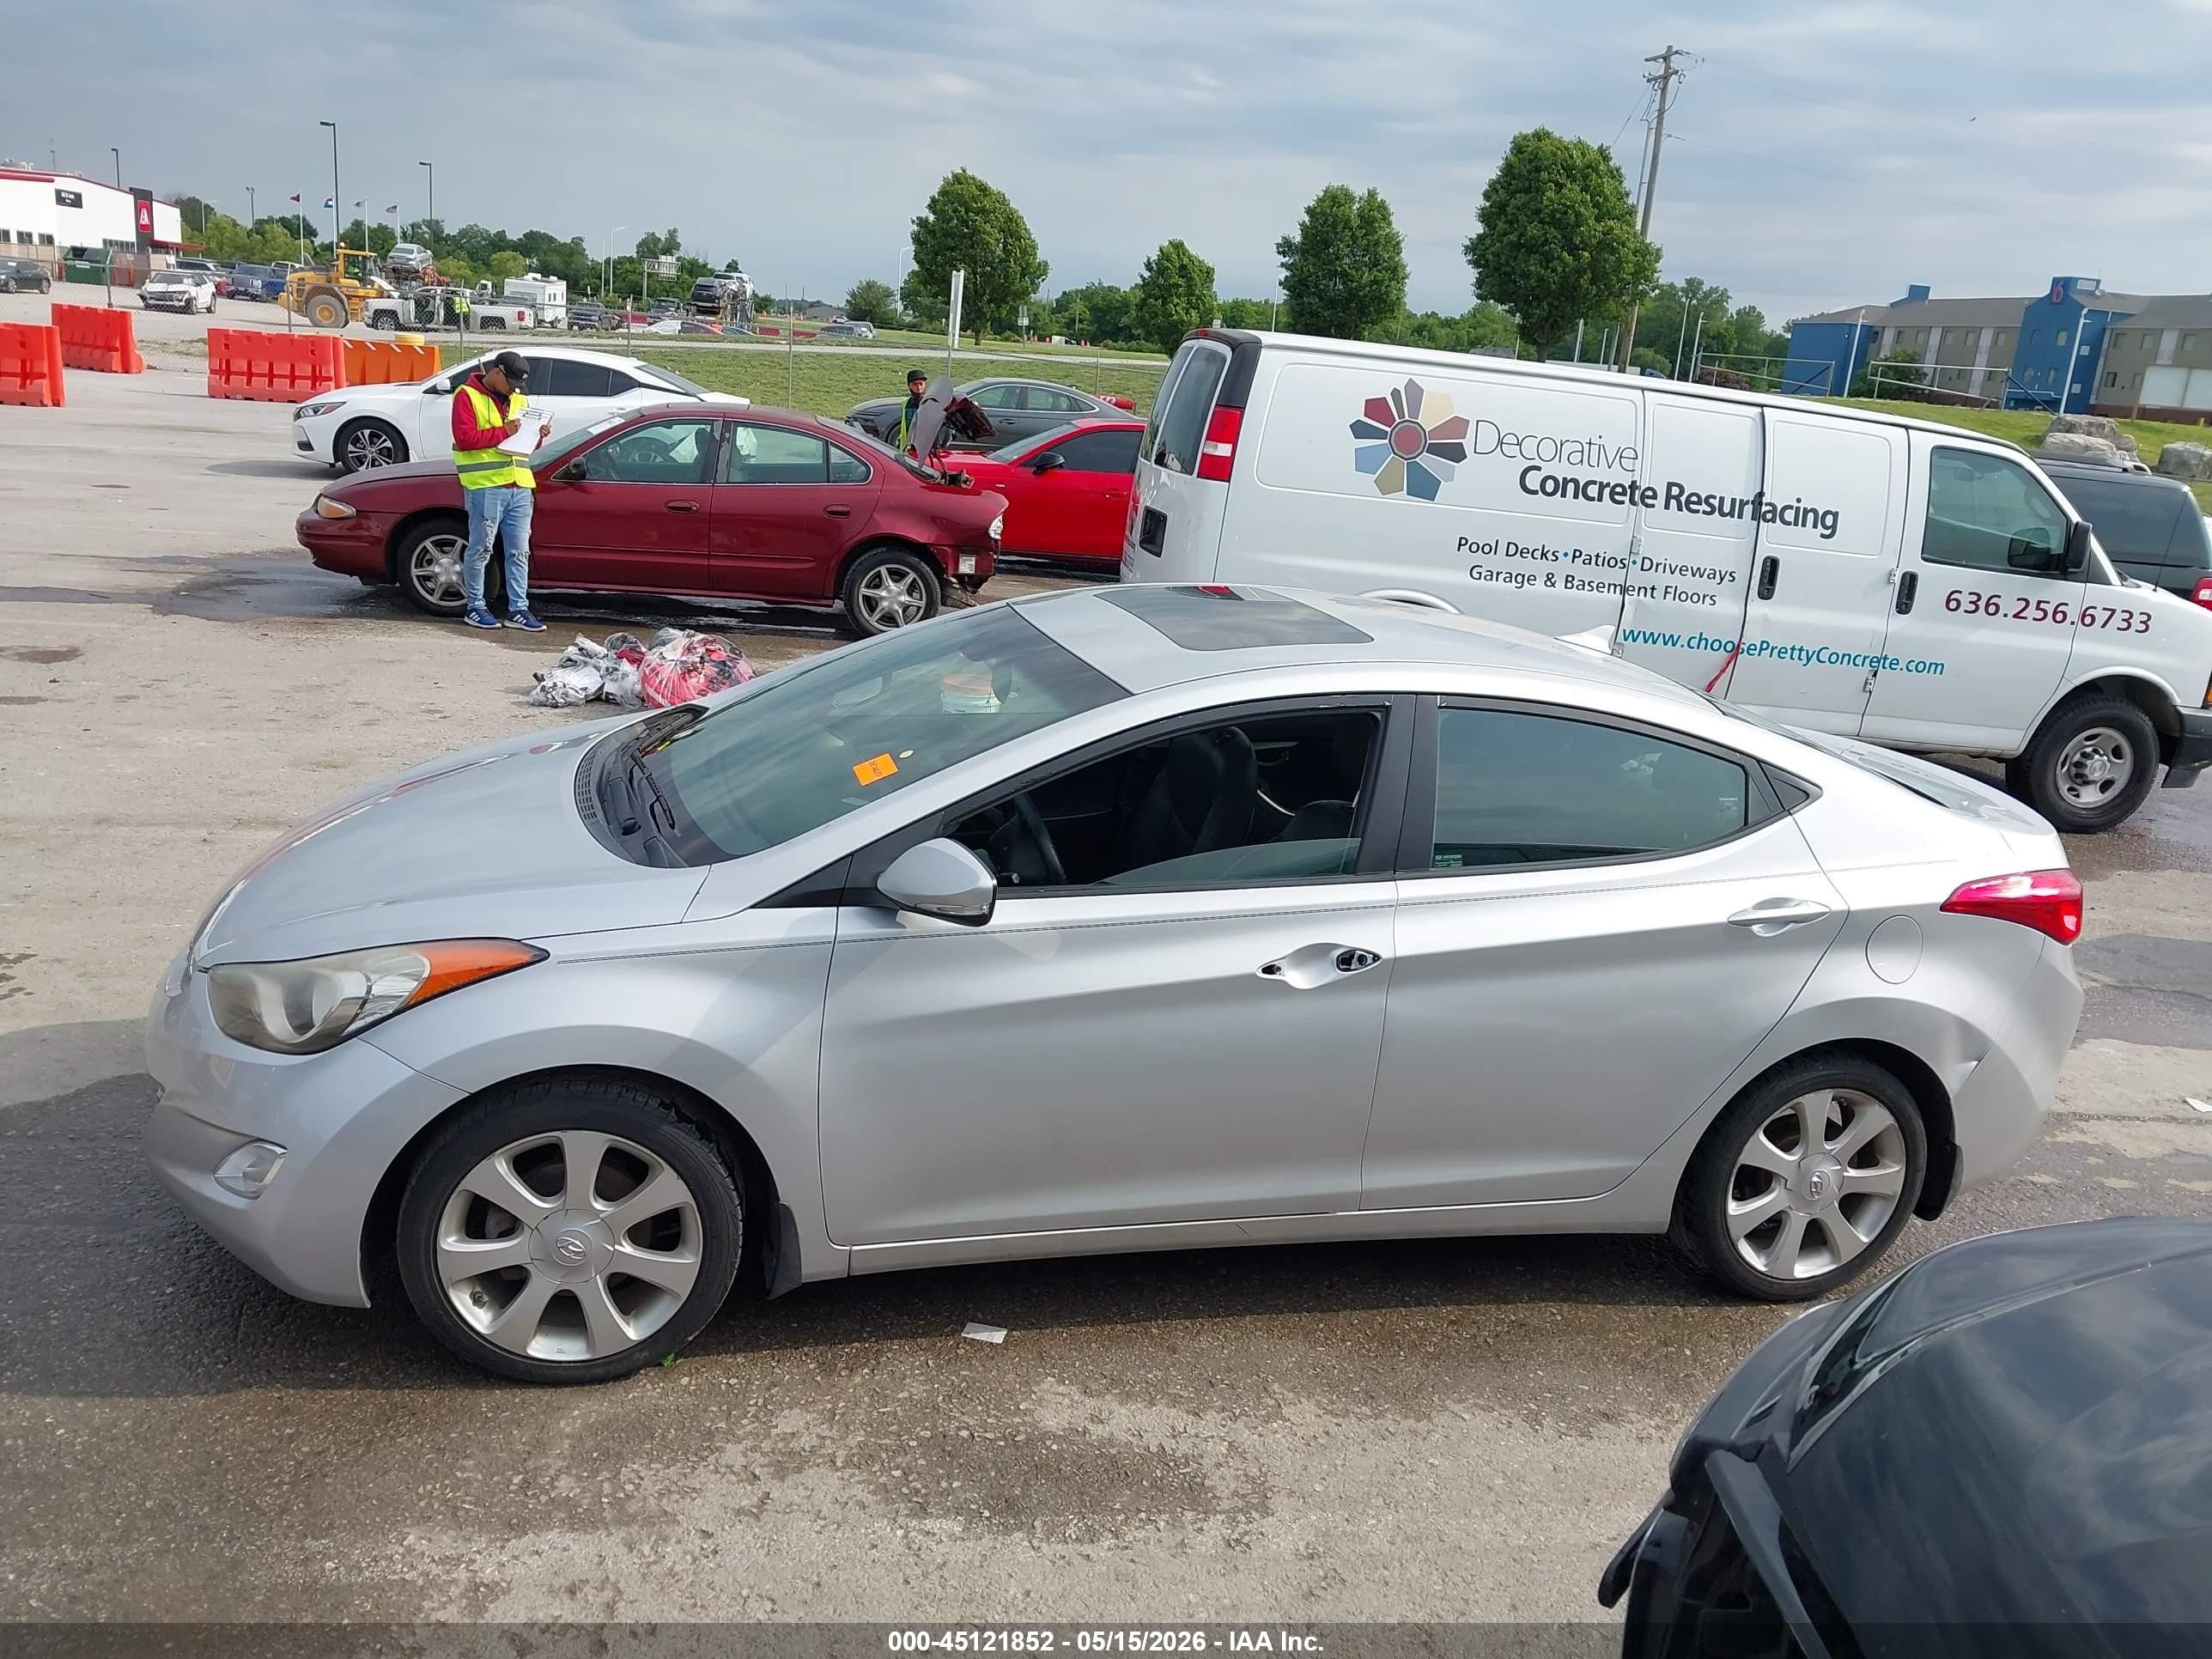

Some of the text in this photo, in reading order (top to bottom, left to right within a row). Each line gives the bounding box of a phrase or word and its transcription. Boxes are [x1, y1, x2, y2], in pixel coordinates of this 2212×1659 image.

[1474, 419, 1638, 472] Decorative
[1519, 465, 1840, 539] Concrete Resurfacing
[1456, 536, 1736, 586] Pool Decks Patios Driveways
[1468, 564, 1717, 606] Garage & Basement Floors
[1944, 589, 2153, 634] 636.256.6733
[1621, 626, 1945, 676] www.choosePrettyConcrete.com
